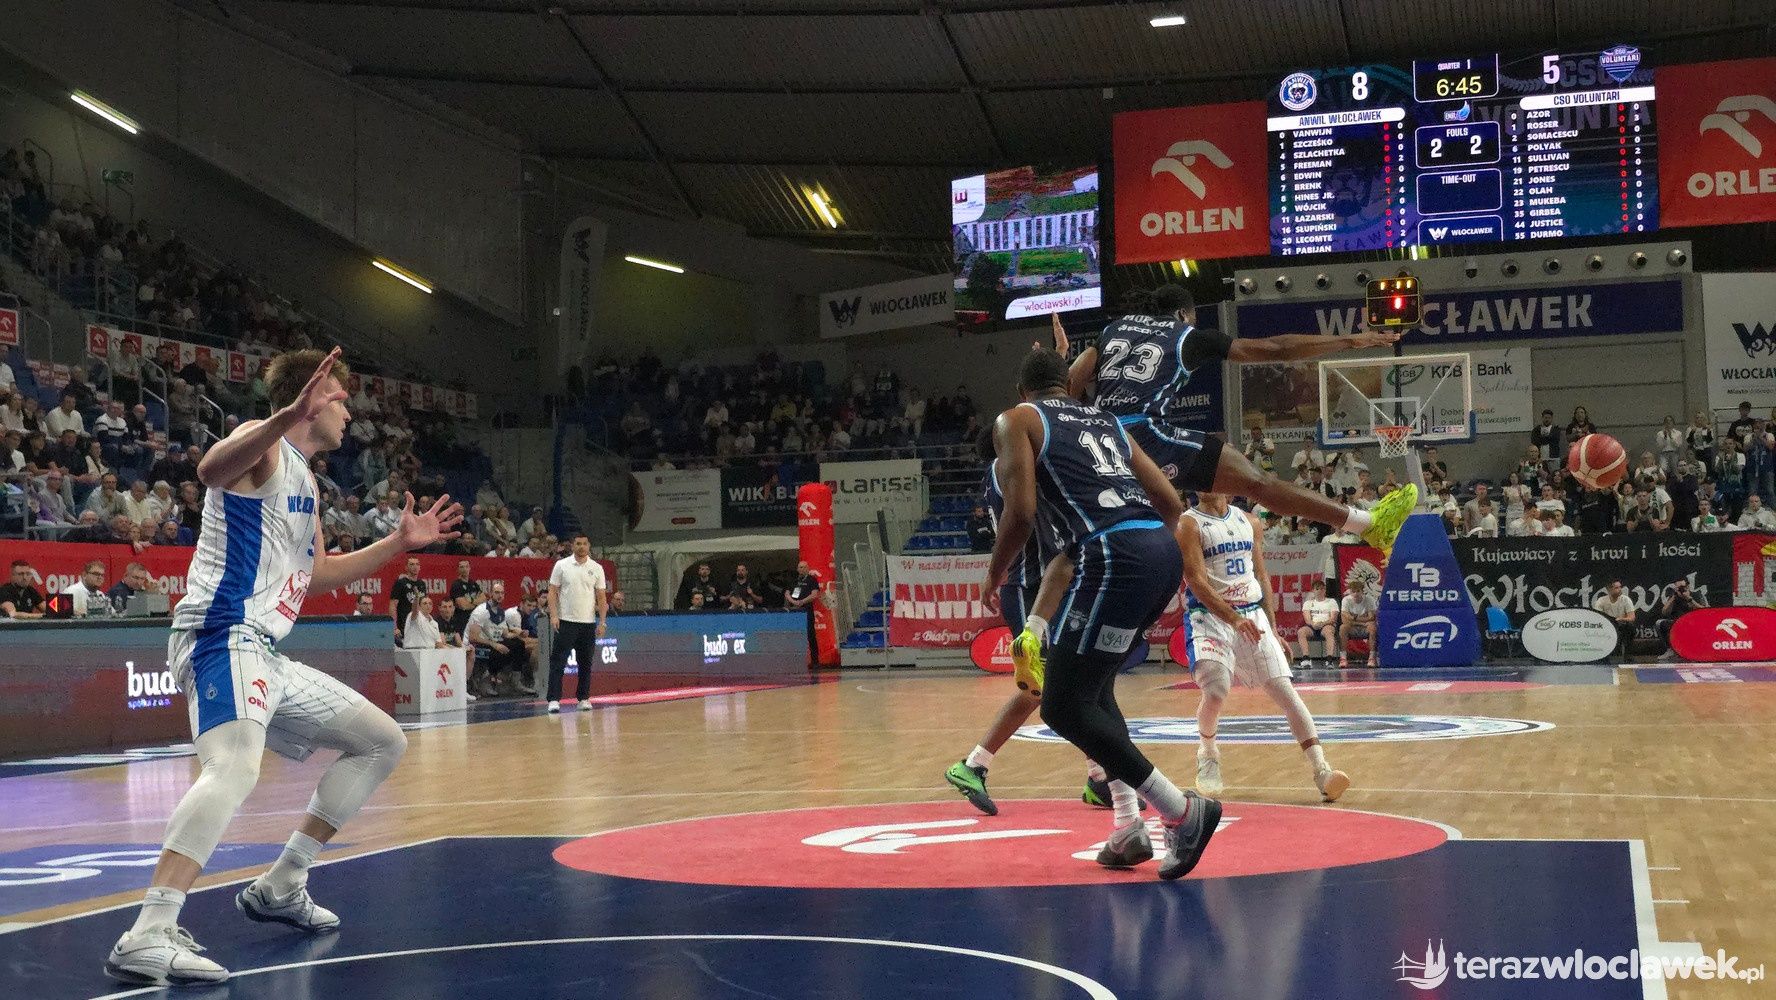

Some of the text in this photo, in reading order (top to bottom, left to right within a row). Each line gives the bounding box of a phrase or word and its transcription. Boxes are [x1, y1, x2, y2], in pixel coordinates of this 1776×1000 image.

[1602, 54, 1639, 64] VOLUNTARI
[1543, 55, 1560, 85] 5
[1352, 72, 1368, 100] 8
[1436, 75, 1482, 96] 6:45
[1554, 91, 1620, 105] CSO VOLUNTARI
[1299, 110, 1382, 126] ANWIL WŁOCŁAWEK
[1511, 112, 1517, 120] 0
[1526, 110, 1551, 119] AZOR
[1527, 121, 1559, 130] ROSSER
[1293, 128, 1333, 138] VANWIJN
[1446, 128, 1468, 137] FOULS
[1527, 130, 1579, 141] SOMACESCU
[1430, 135, 1482, 158] 2 2
[1527, 142, 1562, 151] POLYAK
[1293, 148, 1346, 159] SZLACHETKA
[1512, 156, 1521, 164] 11
[1527, 152, 1570, 163] SULLIVAN
[1293, 160, 1332, 170] FREEMAN
[1528, 163, 1570, 174] PETRESCU
[1294, 171, 1322, 180] EDWIN
[1441, 174, 1476, 185] TIME-OUT
[1528, 175, 1556, 185] JONES
[1294, 182, 1322, 191] BRENK
[1687, 168, 1776, 198] ORLE
[1529, 186, 1553, 195] OLAH
[1294, 193, 1319, 202] HINES
[1322, 192, 1335, 200] JR.
[1529, 196, 1566, 206] MUKEBA
[1530, 208, 1561, 217] GIRBEA
[1140, 206, 1244, 237] ORLEN
[1515, 221, 1525, 229] 44
[1530, 219, 1564, 228] JUSTICE
[1296, 235, 1333, 244] LECOMTE
[1530, 230, 1563, 239] DURMO
[1296, 245, 1332, 255] PABIJAN
[870, 291, 947, 315] WŁOCŁAWEK
[1098, 337, 1165, 384] 23
[1431, 365, 1473, 379] KDB
[1477, 363, 1513, 377] Bank
[1078, 430, 1134, 478] 11
[1473, 542, 1701, 564] Kujawiacy z krwi i kości
[903, 560, 915, 571] W
[1226, 558, 1246, 576] 20
[1405, 563, 1440, 588] TB
[1386, 590, 1459, 602] TERBUD
[1559, 621, 1582, 629] KDBS
[1584, 621, 1603, 629] Bank
[1394, 632, 1444, 649] PGE
[1712, 640, 1753, 650] ORLEN
[435, 689, 454, 699] ORLEN
